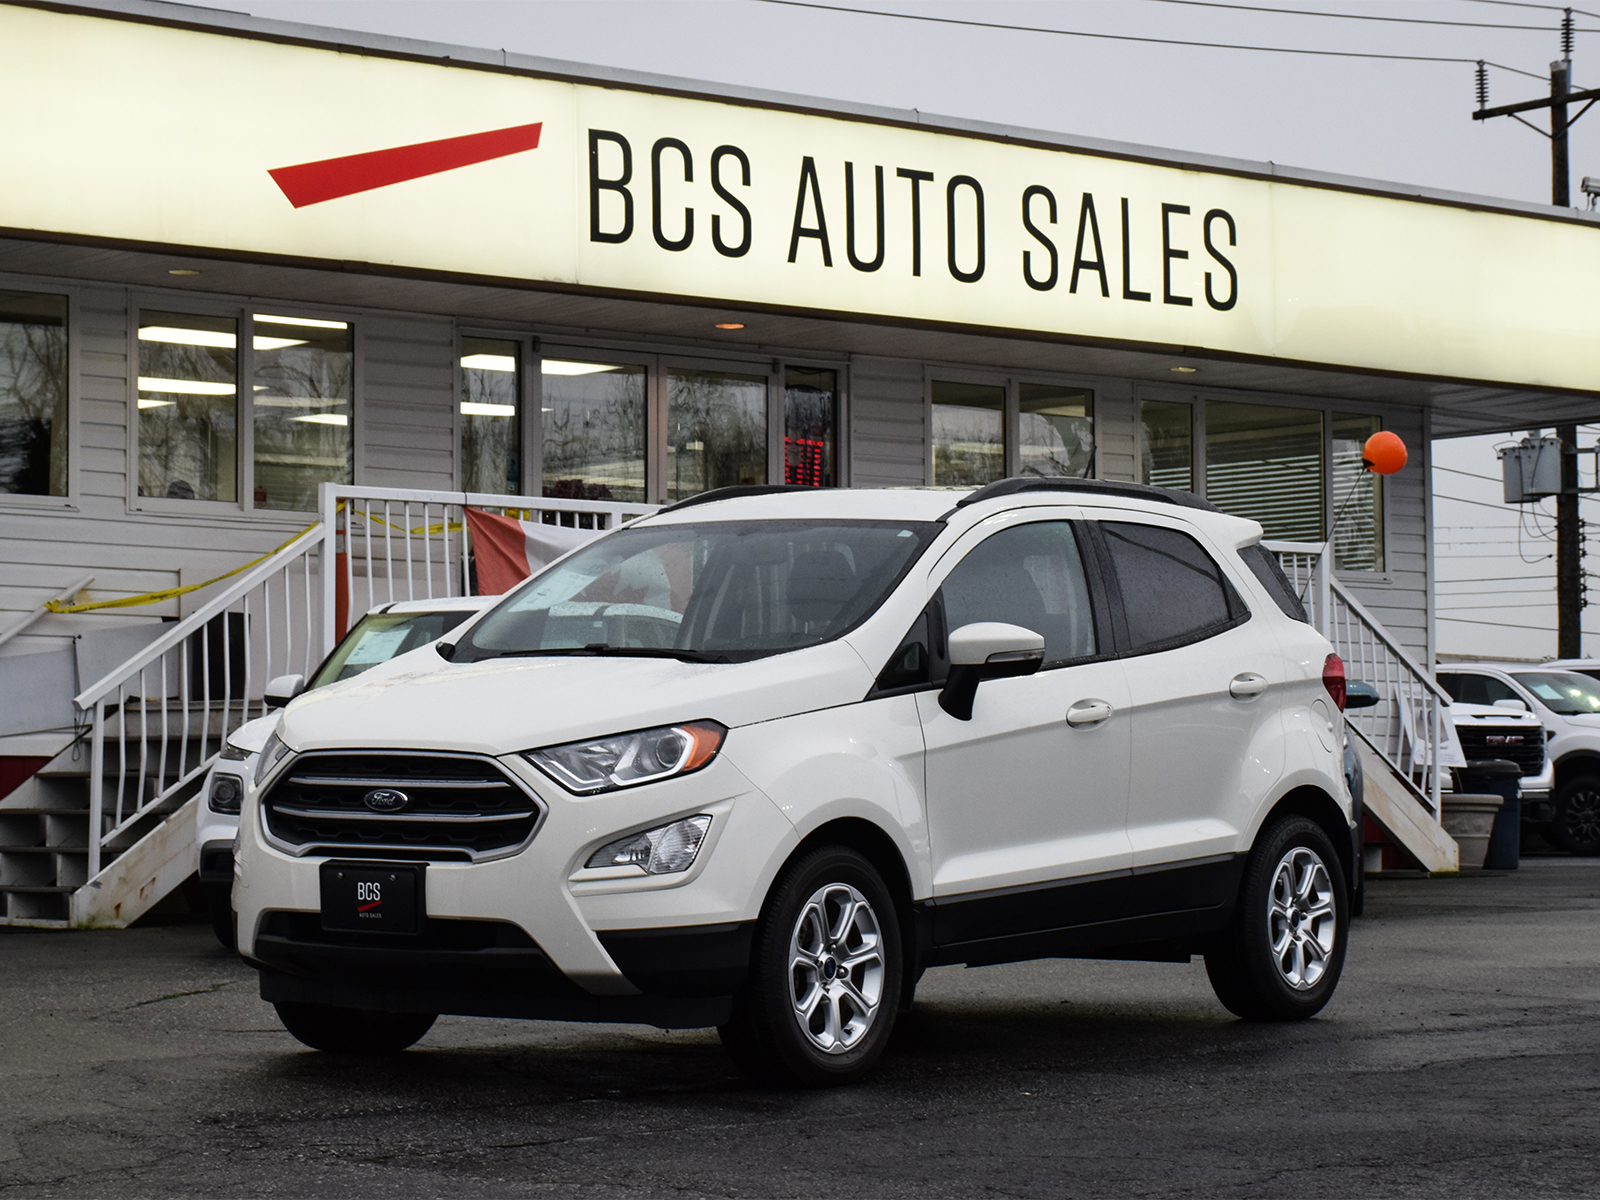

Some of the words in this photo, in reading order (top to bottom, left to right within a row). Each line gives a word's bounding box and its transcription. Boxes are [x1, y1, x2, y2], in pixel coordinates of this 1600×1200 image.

[588, 128, 752, 258] BCS
[787, 155, 986, 284] AUTO
[1022, 184, 1238, 312] SALES
[371, 791, 396, 805] Ford
[357, 882, 381, 901] BCS
